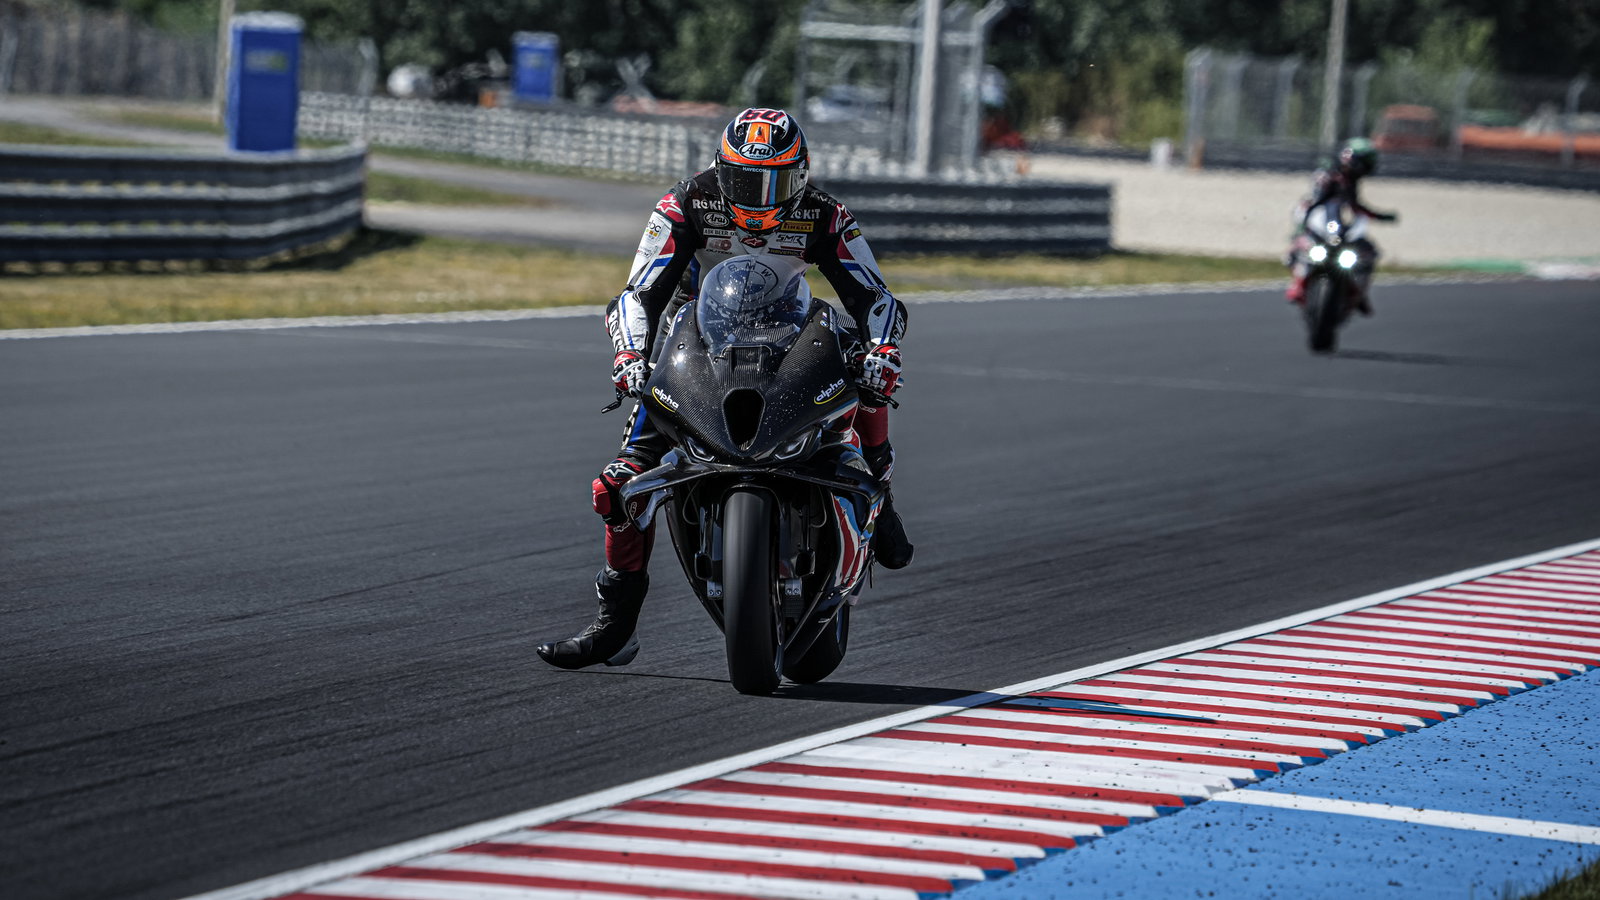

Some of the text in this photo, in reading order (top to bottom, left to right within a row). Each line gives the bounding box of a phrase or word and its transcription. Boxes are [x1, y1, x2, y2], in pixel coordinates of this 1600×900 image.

[740, 108, 786, 123] 60
[741, 144, 773, 156] Arai
[705, 213, 728, 224] Arai
[815, 378, 845, 402] alpha
[654, 387, 680, 409] alpha
